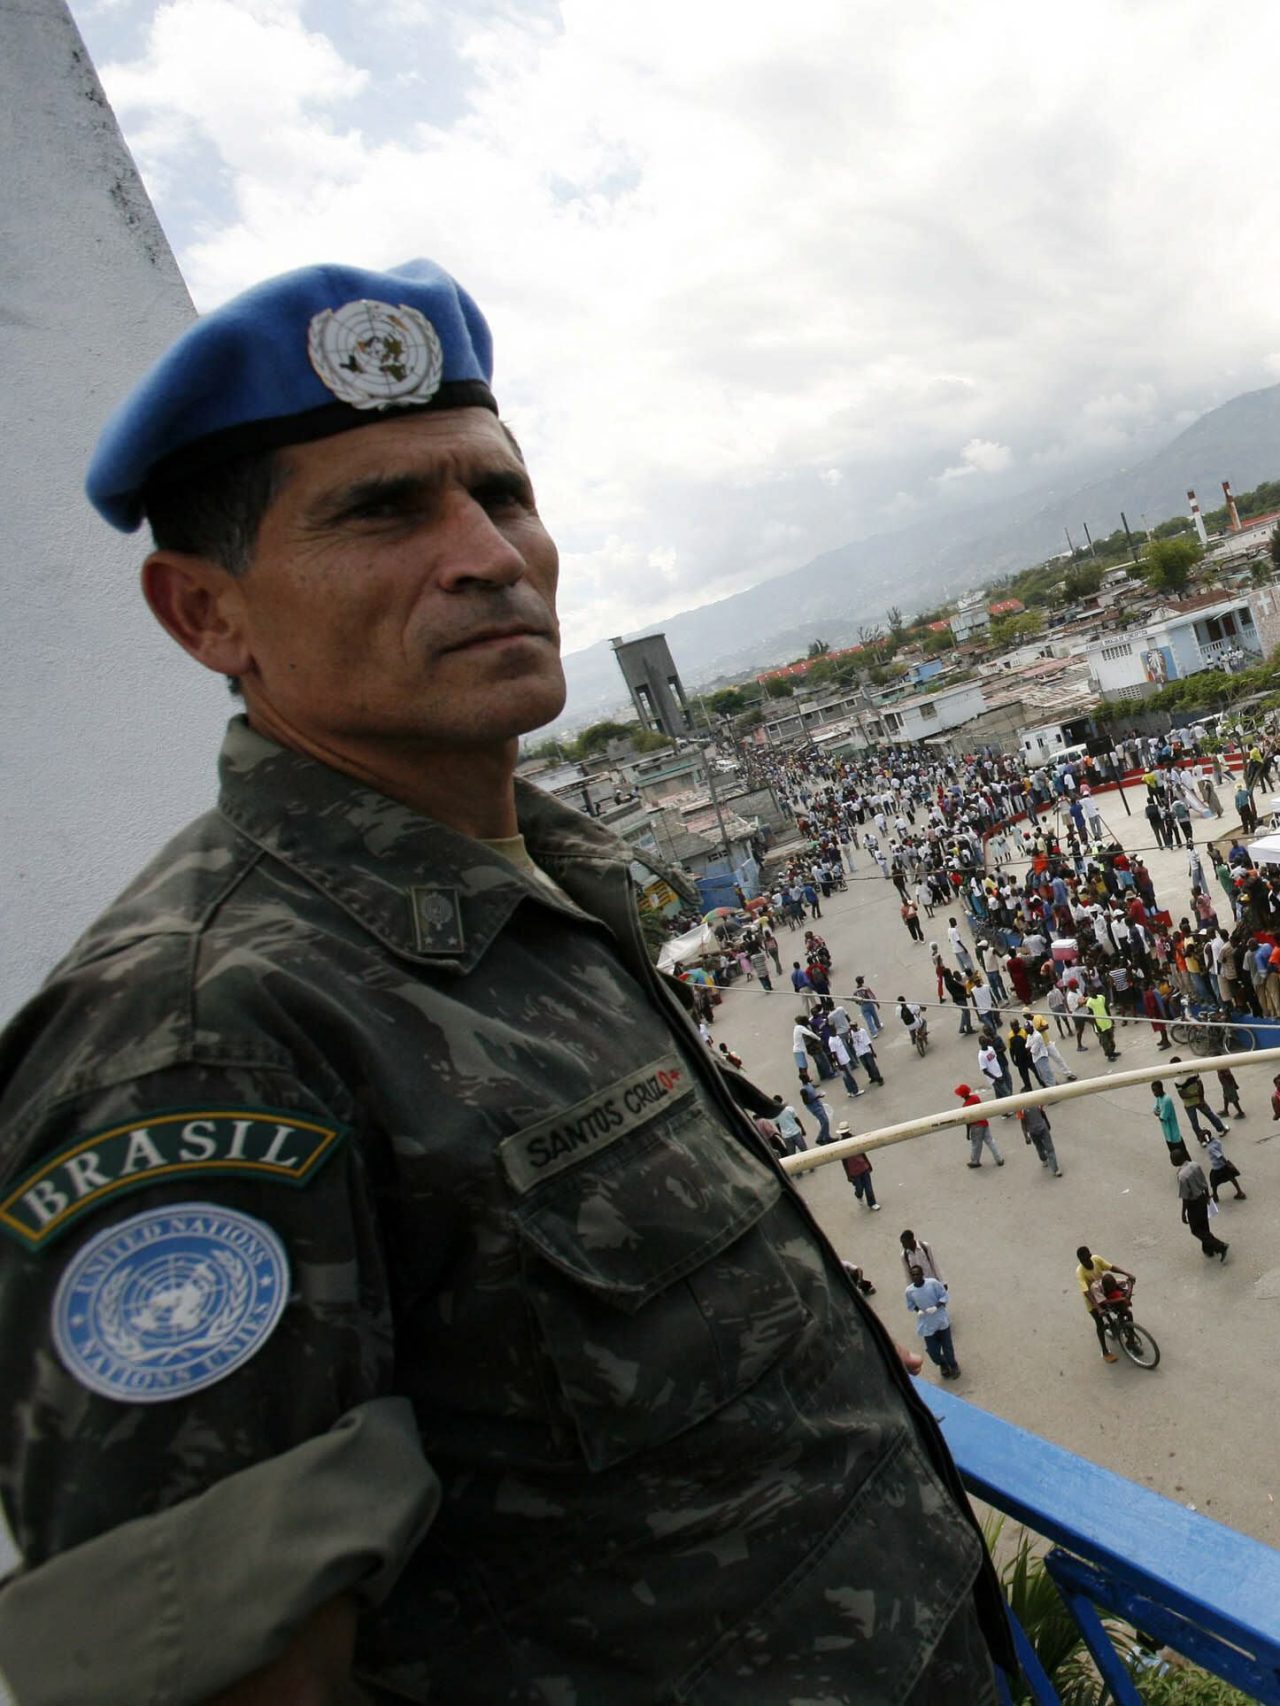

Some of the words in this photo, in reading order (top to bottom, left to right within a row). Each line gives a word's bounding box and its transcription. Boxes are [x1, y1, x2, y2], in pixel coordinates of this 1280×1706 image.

[527, 1099, 624, 1168] SANTOS
[624, 1076, 668, 1114] CRUZ
[22, 1120, 299, 1226] BRASIL
[74, 1225, 162, 1293] UNITED
[168, 1217, 270, 1266] NATIONS
[80, 1338, 192, 1389] NATIONS
